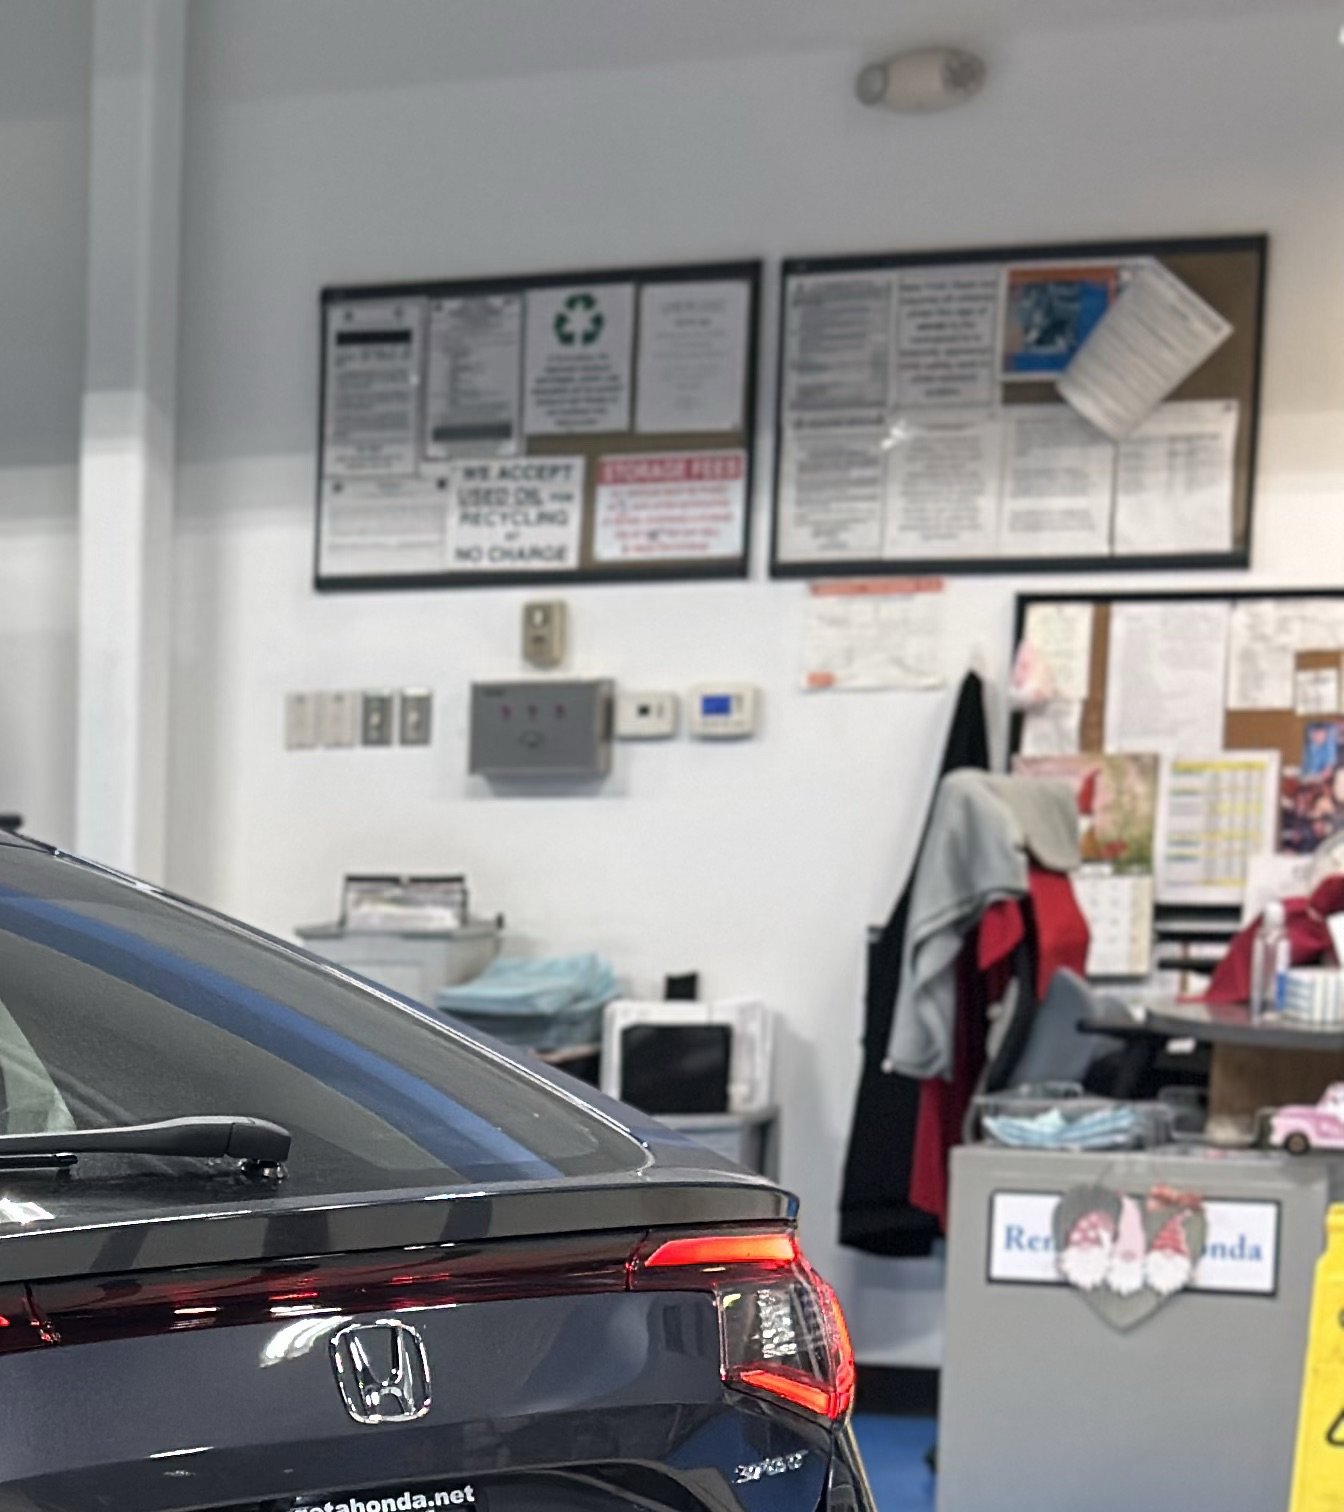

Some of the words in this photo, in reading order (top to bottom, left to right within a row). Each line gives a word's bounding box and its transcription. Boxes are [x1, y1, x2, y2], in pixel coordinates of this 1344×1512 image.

[462, 465, 491, 482] WE
[498, 463, 573, 481] ACCEPT
[459, 510, 569, 527] RECYCLING
[454, 546, 482, 562] NO
[487, 544, 566, 563] CHARGE
